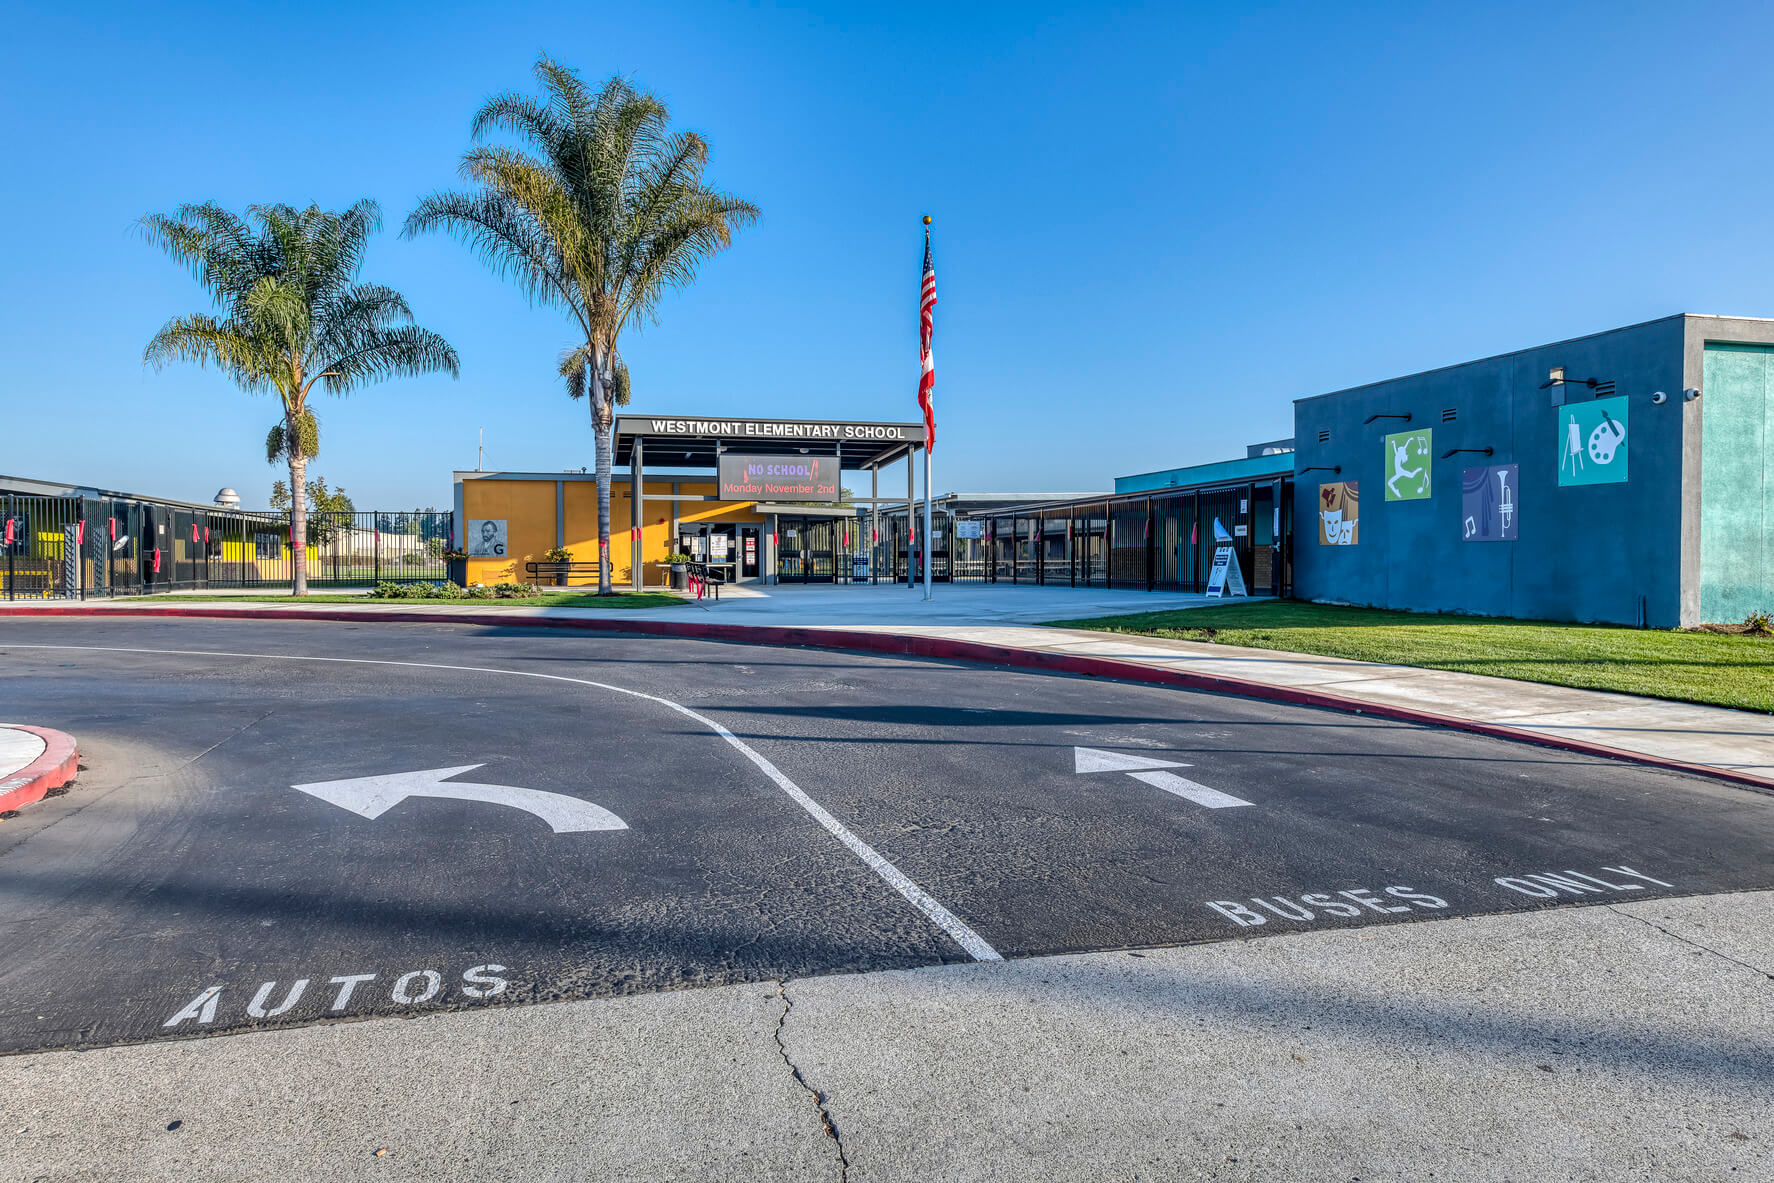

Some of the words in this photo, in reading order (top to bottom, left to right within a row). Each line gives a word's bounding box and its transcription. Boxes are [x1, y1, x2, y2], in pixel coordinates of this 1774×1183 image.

[652, 420, 741, 434] WESTMONT
[745, 423, 840, 437] ELEMENTARY
[844, 426, 905, 439] SCHOOL
[749, 464, 763, 475] NO
[767, 464, 810, 476] SCHOOL
[724, 483, 763, 495] Monday
[766, 483, 813, 494] November
[817, 484, 835, 494] 2nd
[493, 544, 504, 555] G
[1205, 886, 1449, 927] BUSES
[1494, 866, 1674, 897] ONLY
[163, 964, 507, 1027] AUTOS
